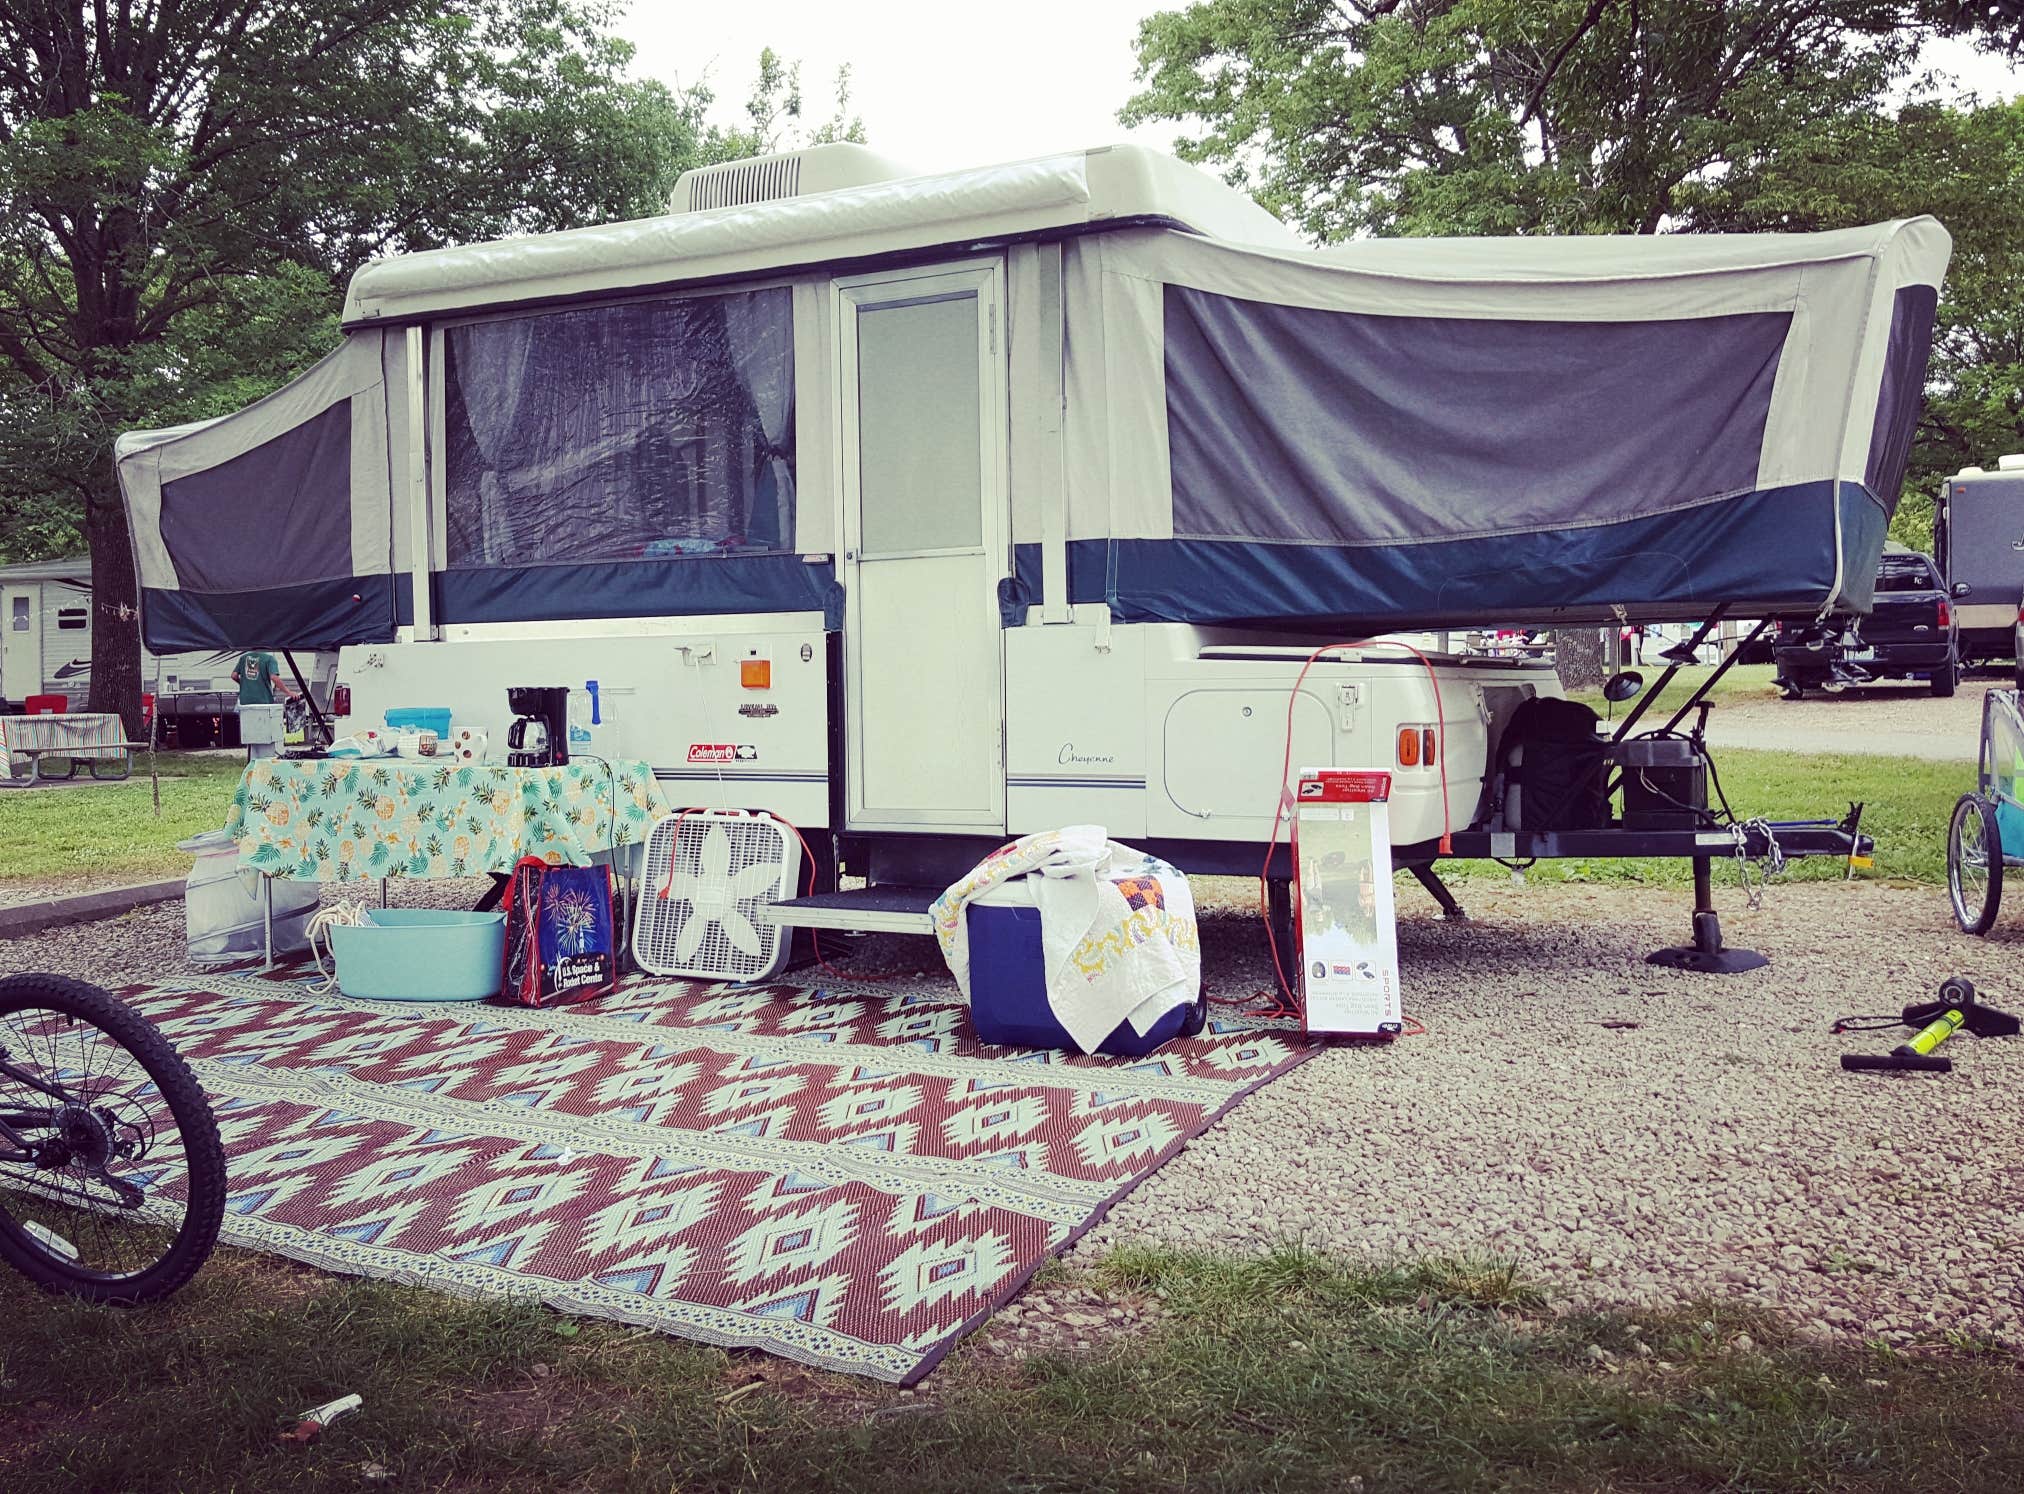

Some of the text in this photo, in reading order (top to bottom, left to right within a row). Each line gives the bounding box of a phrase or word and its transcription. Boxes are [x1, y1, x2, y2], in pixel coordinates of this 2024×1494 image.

[690, 745, 725, 759] Coleman
[1058, 742, 1114, 765] Cheyenne
[572, 963, 593, 976] Space
[594, 961, 601, 972] &
[563, 973, 603, 988] Rocket Center
[1382, 969, 1391, 1016] SPORTS
